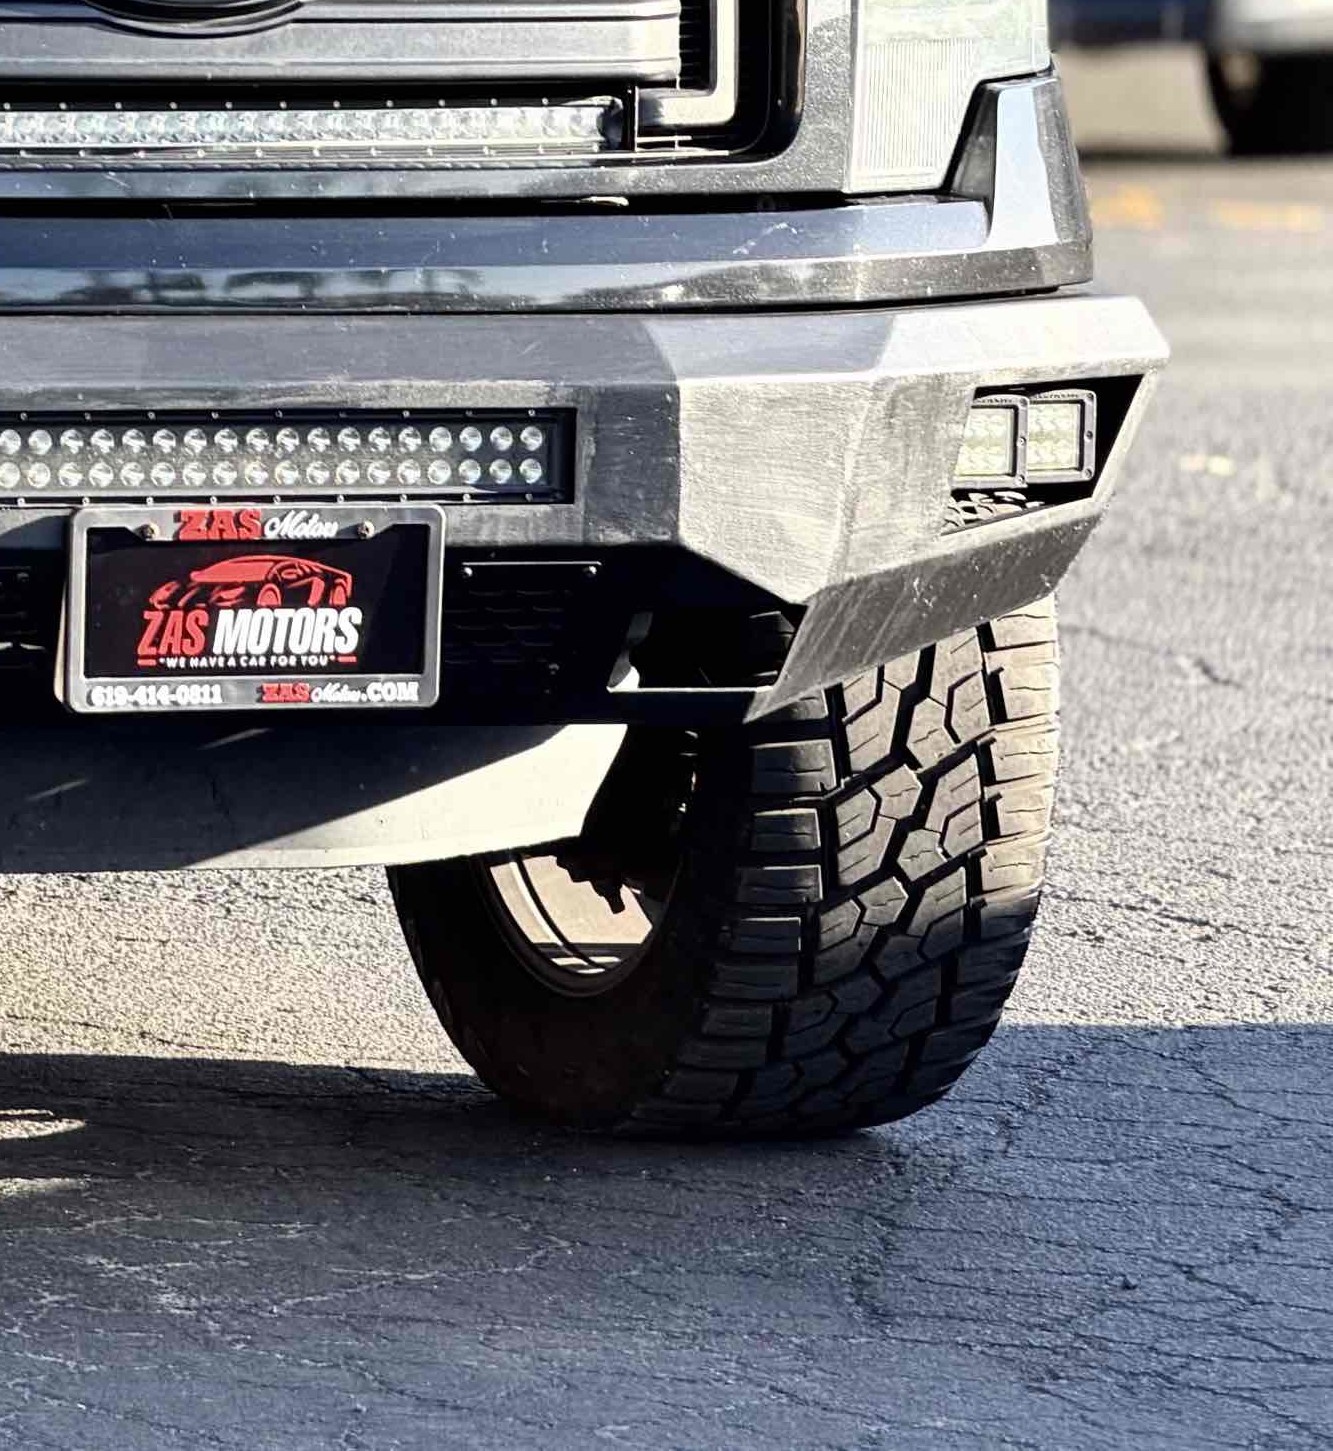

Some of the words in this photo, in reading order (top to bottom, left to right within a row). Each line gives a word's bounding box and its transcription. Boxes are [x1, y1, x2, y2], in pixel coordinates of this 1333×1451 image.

[178, 509, 262, 540] ZAS
[137, 609, 209, 656] ZAS
[212, 606, 363, 655] MOTORS
[189, 656, 225, 668] HAVE
[227, 656, 236, 667] A
[239, 655, 266, 667] CAR
[269, 655, 296, 667] FOR
